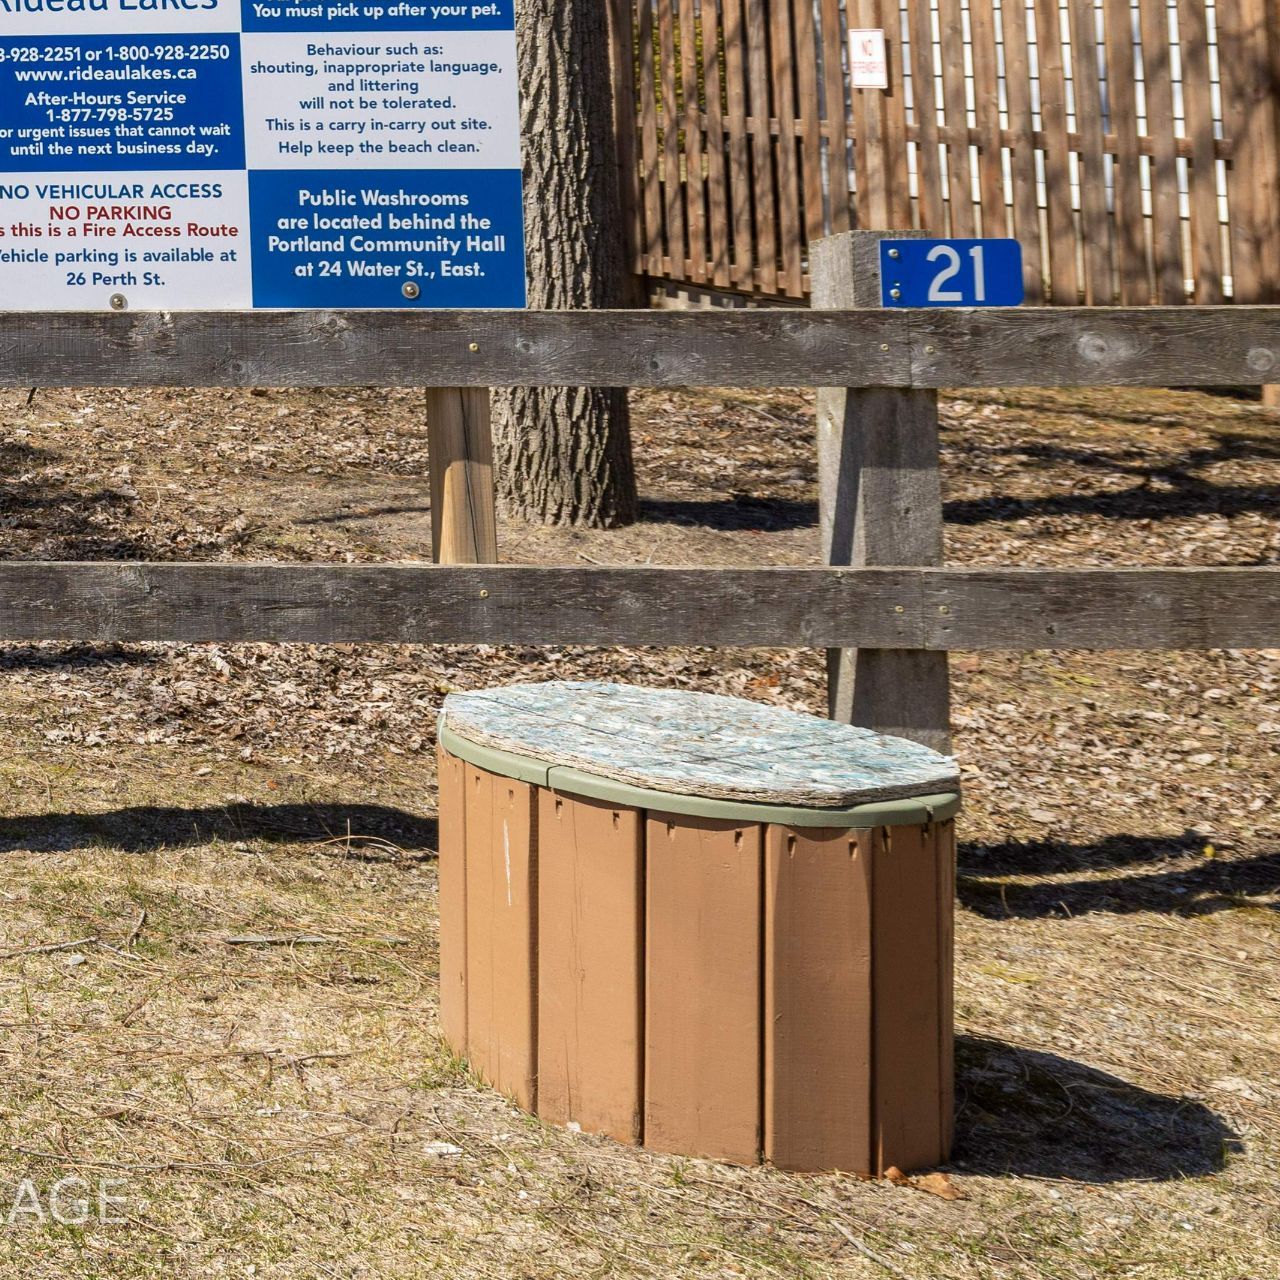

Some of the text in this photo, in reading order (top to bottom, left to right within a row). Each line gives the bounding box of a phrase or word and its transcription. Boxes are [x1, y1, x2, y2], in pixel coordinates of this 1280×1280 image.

[253, 2, 500, 20] You must pick up after your pet.
[85, 51, 102, 61] or
[106, 45, 229, 60] 1-800-928-2250
[307, 43, 442, 55] Behaviour such as:
[15, 65, 196, 81] www.rideaulakes.ca
[251, 60, 502, 76] shouting, inappropriate language,
[328, 79, 418, 94] and littering
[25, 91, 186, 105] After-Hours Service
[300, 96, 456, 109] will not be tolerated.
[46, 108, 173, 122] 1-877-798-5725
[279, 140, 479, 156] Help keep the beach clean.
[0, 184, 222, 199] NO VEHICULAR ACCESS
[300, 190, 468, 206] Public Washrooms
[50, 206, 171, 220] NO PARKING
[278, 213, 490, 229] are located behind the
[11, 222, 42, 236] this
[48, 223, 61, 236] is
[68, 227, 76, 236] a
[84, 223, 116, 236] Fire
[123, 223, 180, 236] Access
[188, 223, 238, 236] Route
[269, 236, 504, 256] Portland Community Hall
[295, 260, 484, 279] at 24 Water St., East.
[926, 245, 986, 302] 21
